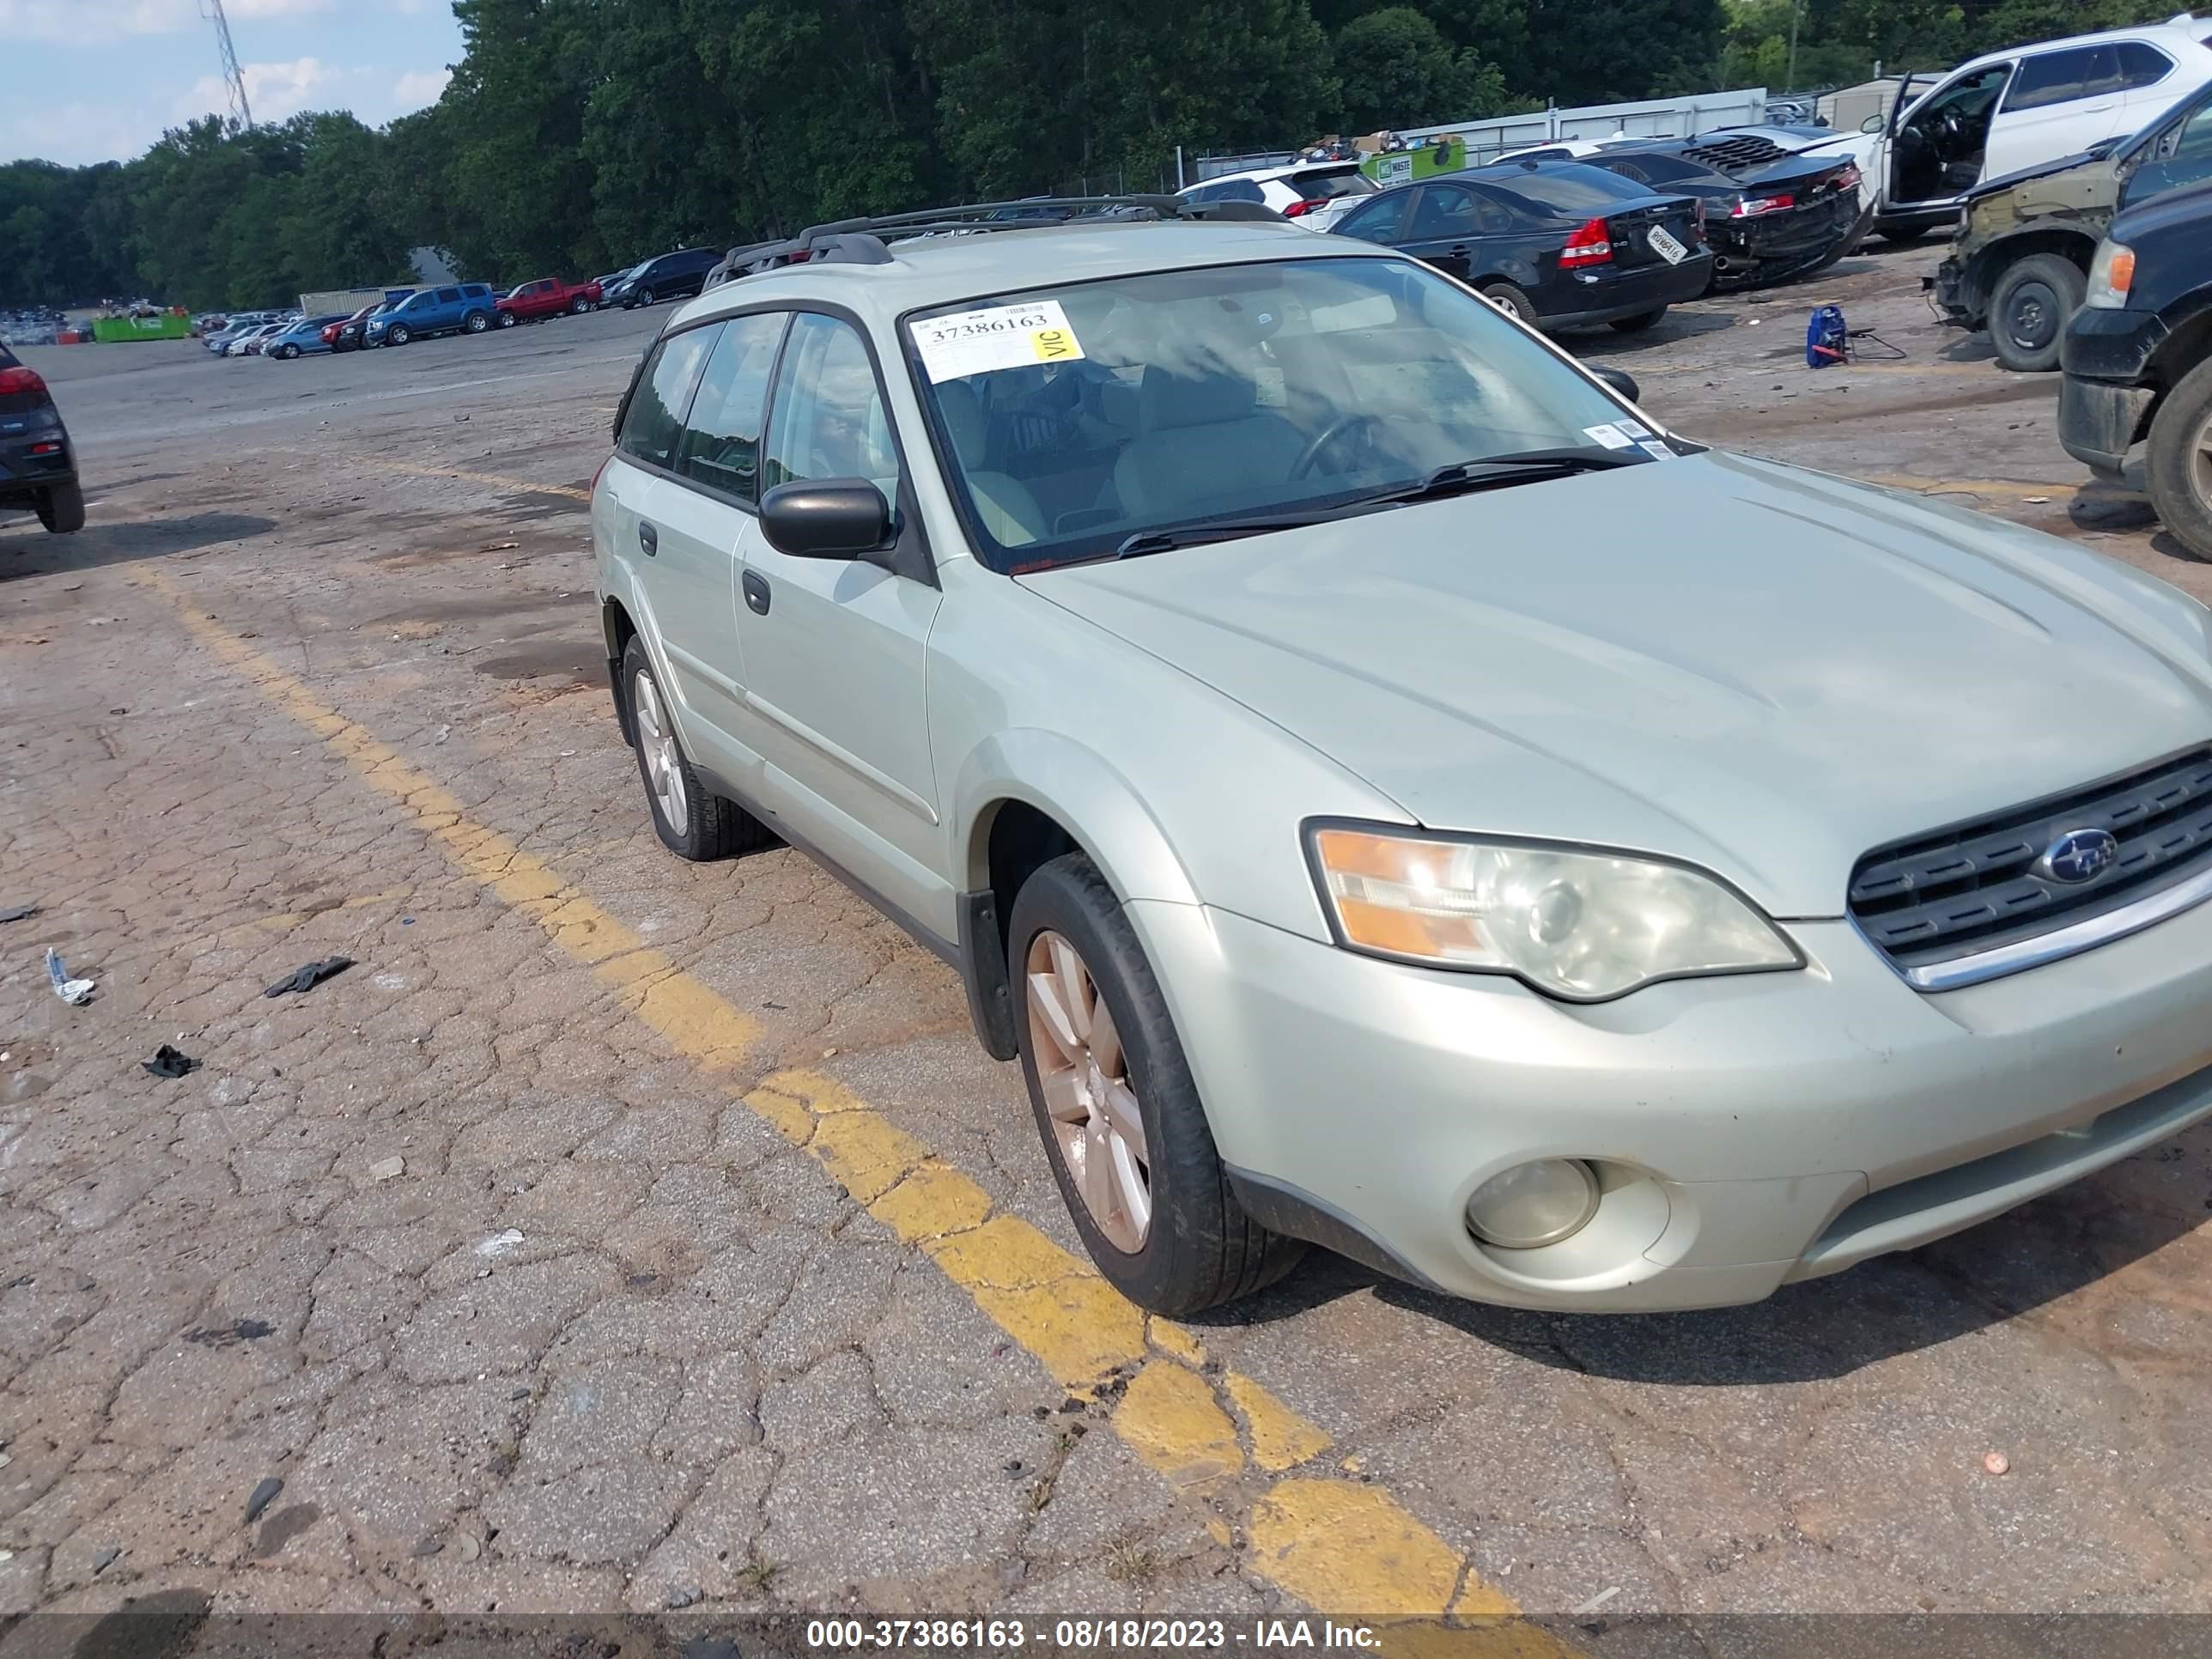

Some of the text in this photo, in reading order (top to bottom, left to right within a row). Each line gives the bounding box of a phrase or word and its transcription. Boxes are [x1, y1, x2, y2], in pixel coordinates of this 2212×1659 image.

[1392, 160, 1410, 173] WASTE
[932, 314, 1047, 343] 37386163
[1039, 331, 1067, 357] VIC
